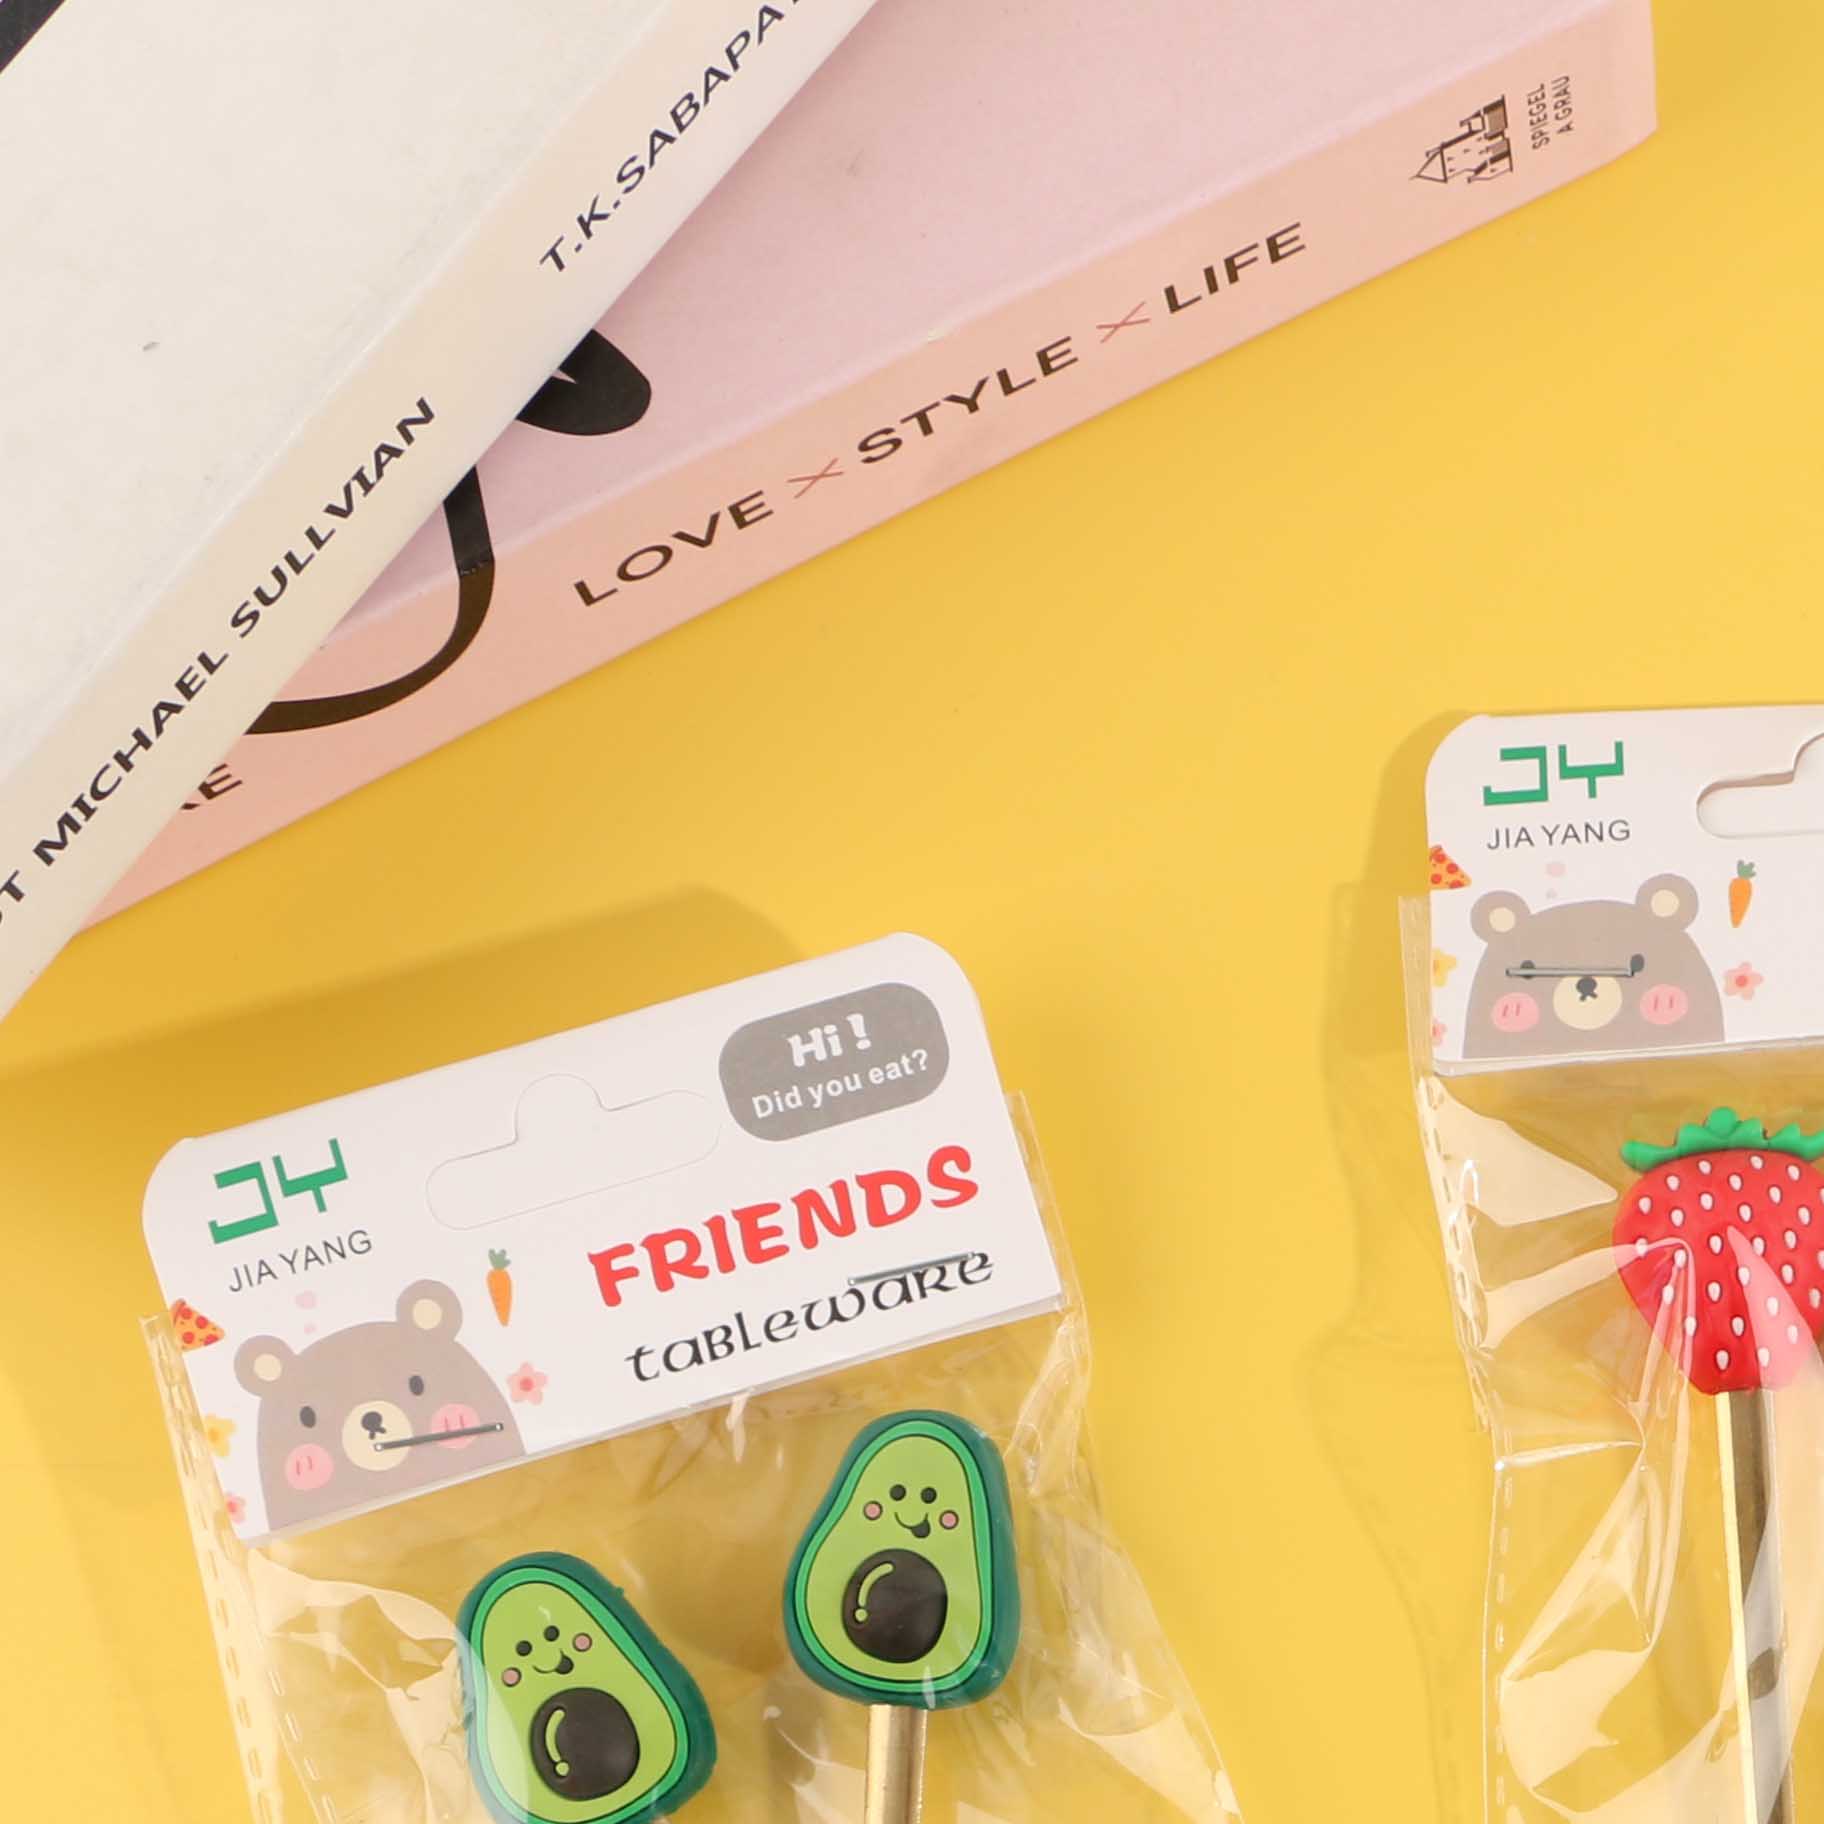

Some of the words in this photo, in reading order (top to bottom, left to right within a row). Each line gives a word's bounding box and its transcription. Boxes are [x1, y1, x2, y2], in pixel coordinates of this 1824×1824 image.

[1526, 83, 1550, 150] SPIEGEL
[1551, 75, 1574, 121] GRAU
[33, 652, 228, 866] MICHAEL
[231, 398, 434, 638] SULLVIAN
[541, 0, 798, 271] T.K.SABAPA
[574, 490, 773, 606] LOVE
[858, 336, 1078, 463] STYLE
[1165, 223, 1305, 313] LIFE
[752, 1086, 802, 1118] Did
[808, 1074, 862, 1108] you
[869, 1049, 927, 1084] eat?
[590, 1146, 977, 1305] FRIENDS
